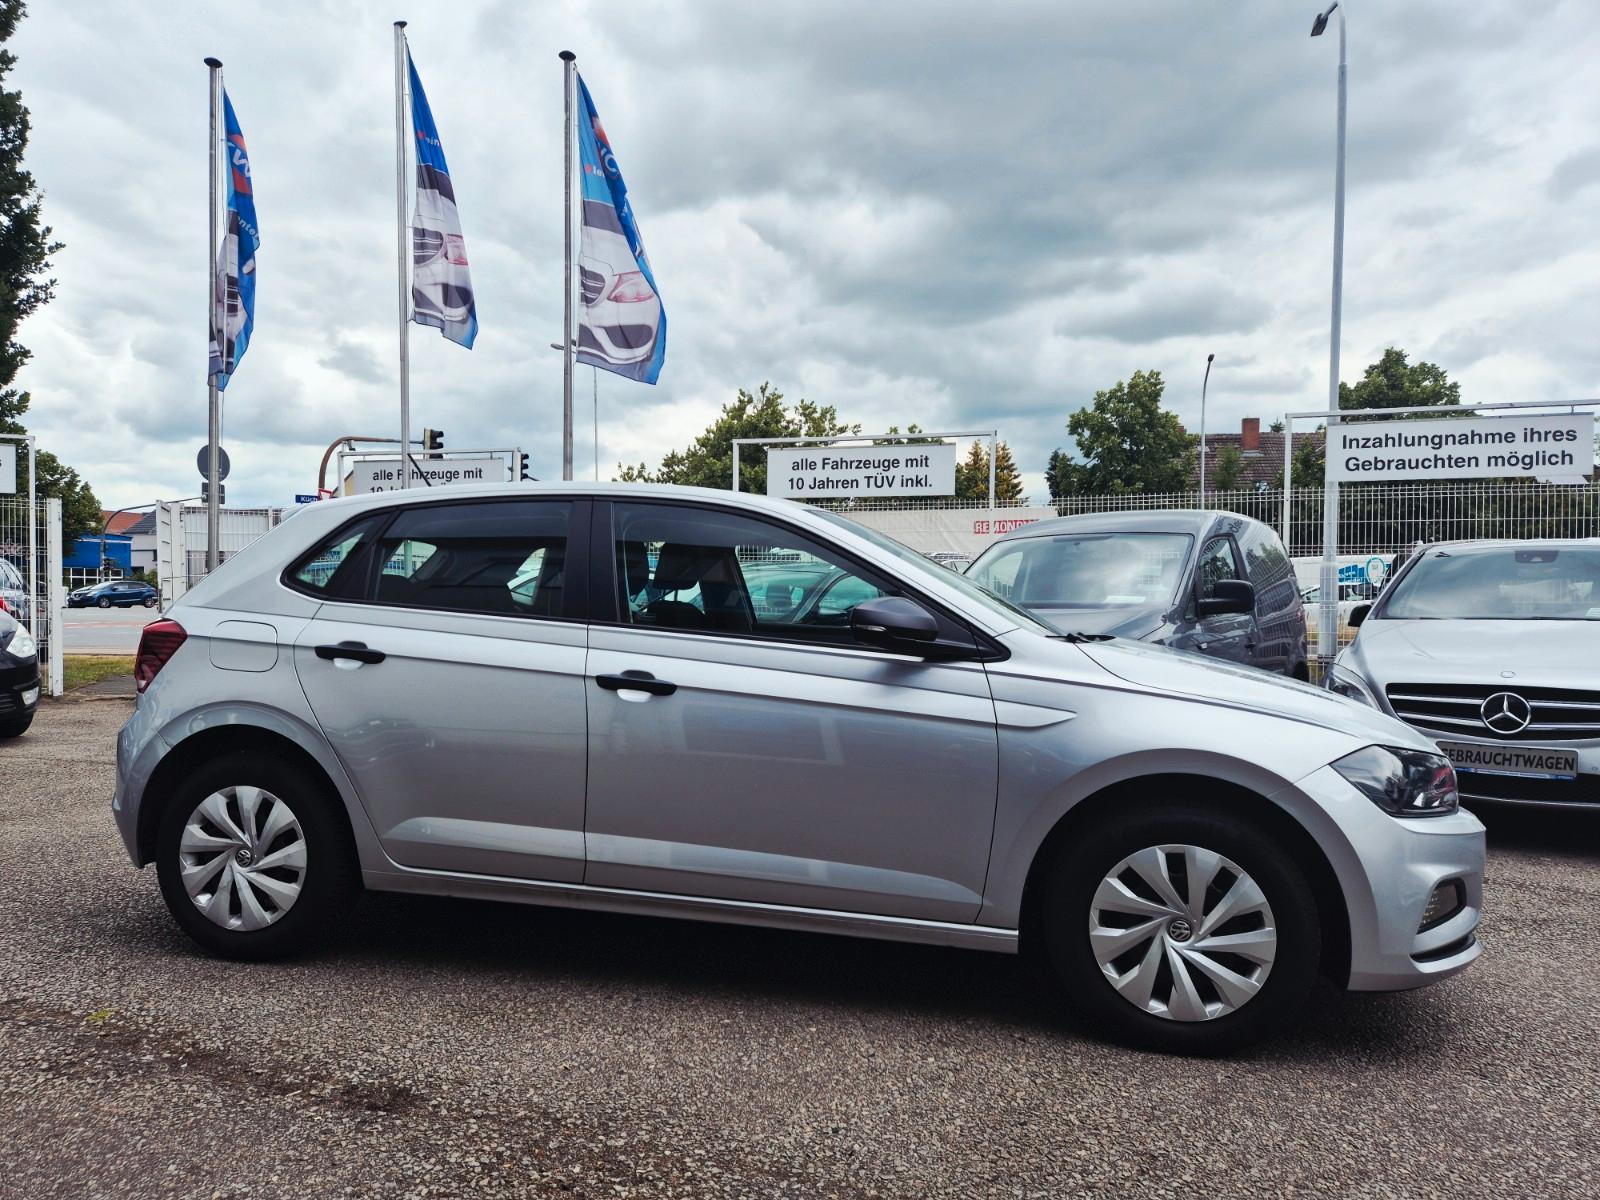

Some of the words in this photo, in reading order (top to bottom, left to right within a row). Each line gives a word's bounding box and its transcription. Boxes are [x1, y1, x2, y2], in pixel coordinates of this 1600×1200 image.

[1342, 430, 1516, 450] Inzahlungnahme
[1523, 427, 1578, 443] ihres
[791, 458, 817, 471] alle
[821, 457, 901, 472] Fahrzeuge
[905, 455, 930, 468] mit
[1345, 455, 1479, 472] Gebrauchten
[1487, 450, 1574, 471] möglich
[372, 470, 394, 481] alle
[397, 468, 460, 482] Fhrzeuge
[463, 467, 483, 480] mit
[788, 477, 805, 490] 10
[808, 477, 859, 490] Jahren
[864, 473, 896, 489] TÜV
[900, 474, 933, 488] inkl.
